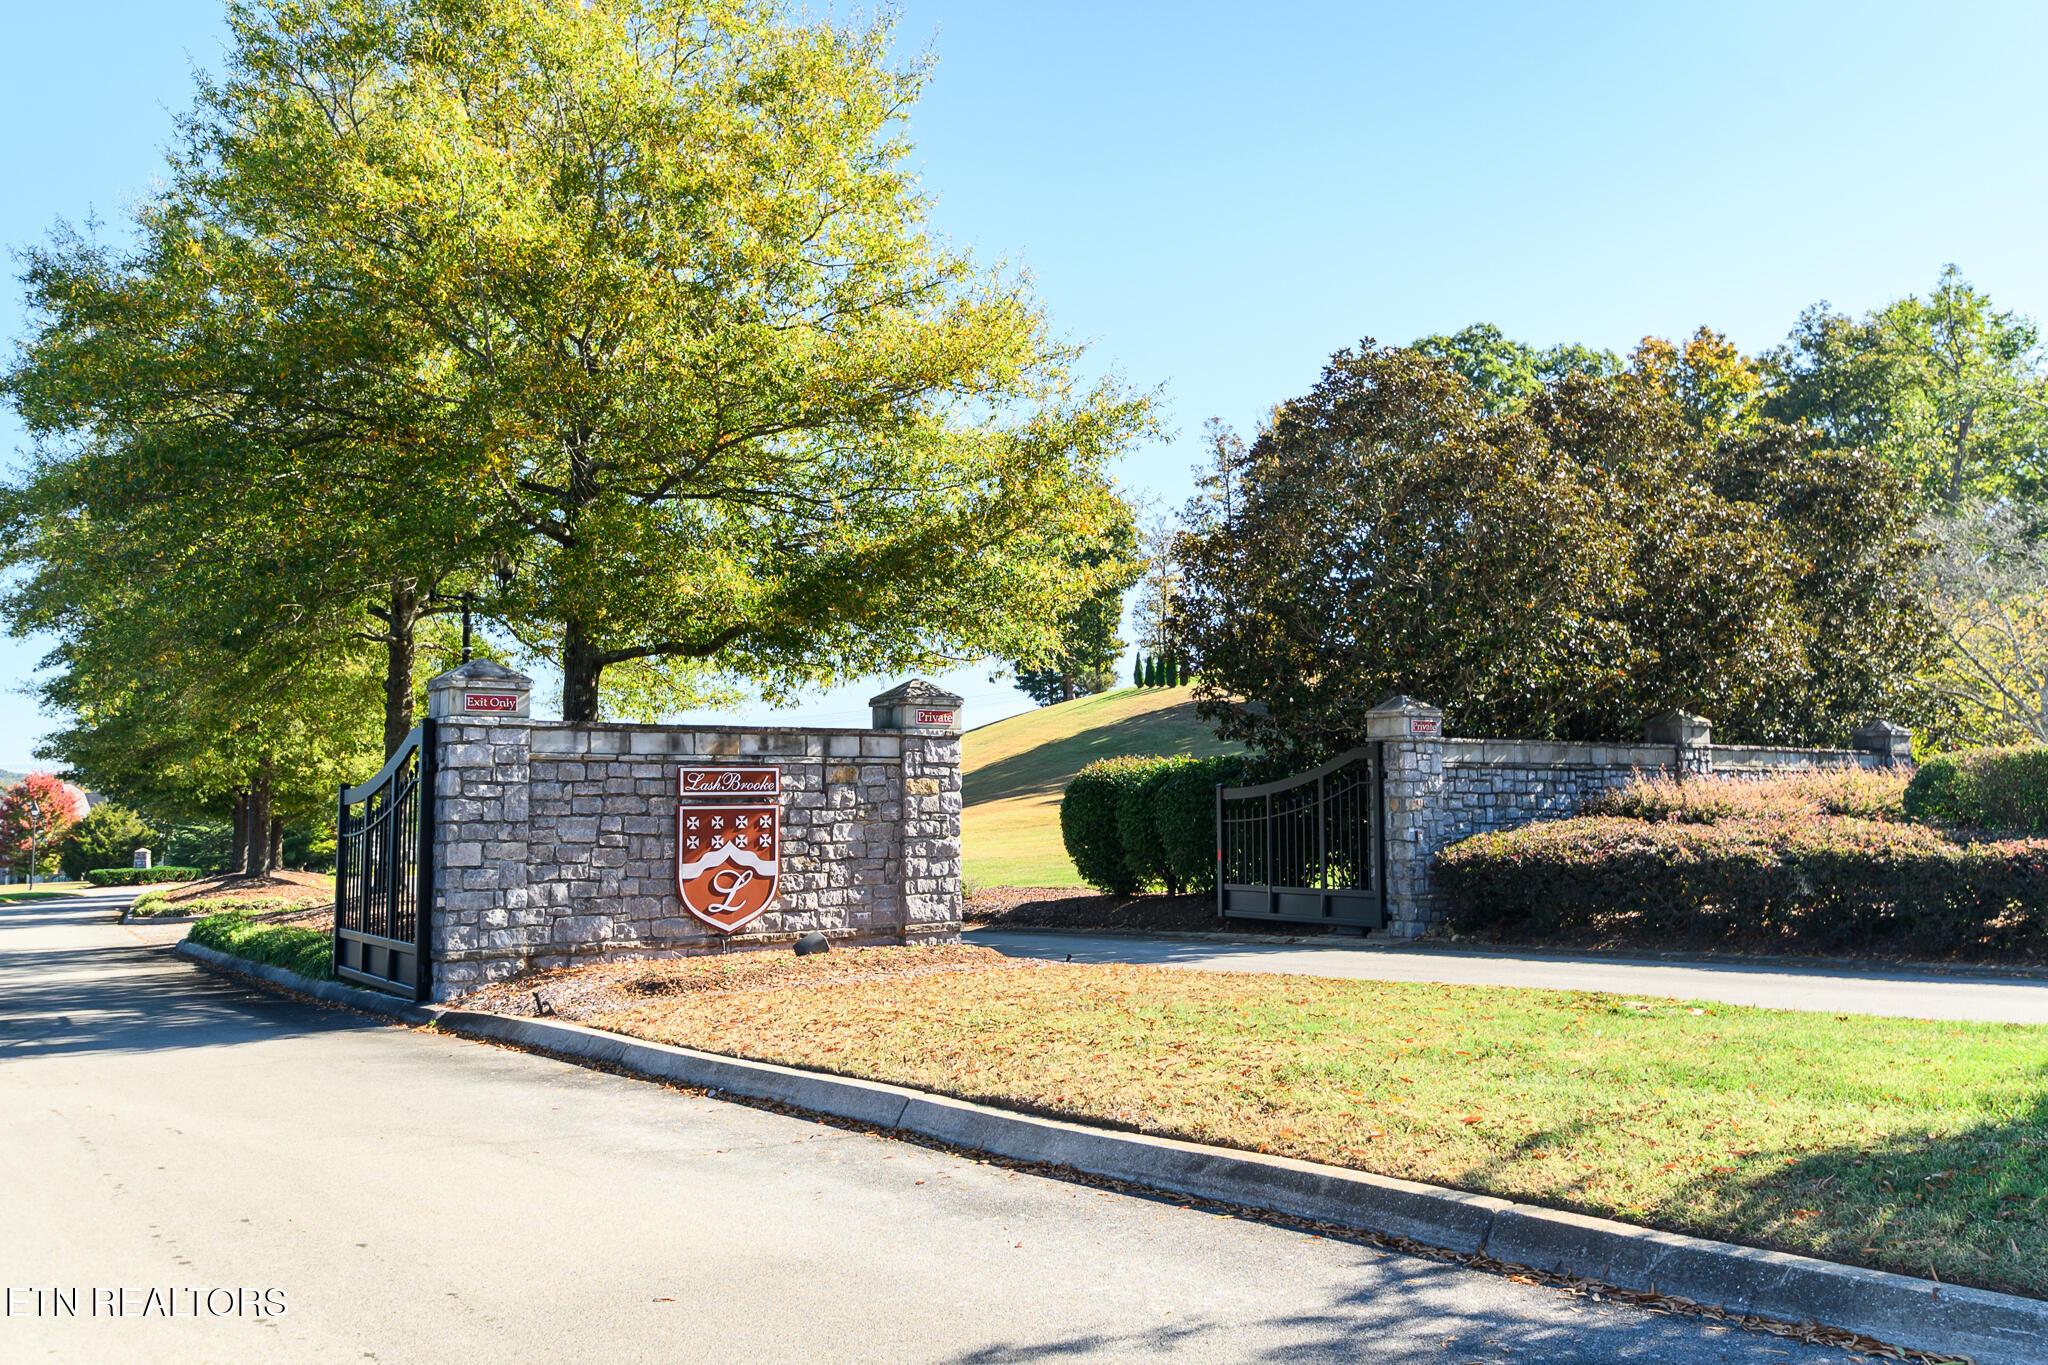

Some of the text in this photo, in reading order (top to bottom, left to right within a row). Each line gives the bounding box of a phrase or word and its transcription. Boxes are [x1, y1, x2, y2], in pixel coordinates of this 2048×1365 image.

[467, 696, 516, 710] Exit Only
[918, 711, 953, 723] Private
[1413, 721, 1438, 731] Private
[708, 869, 753, 912] L
